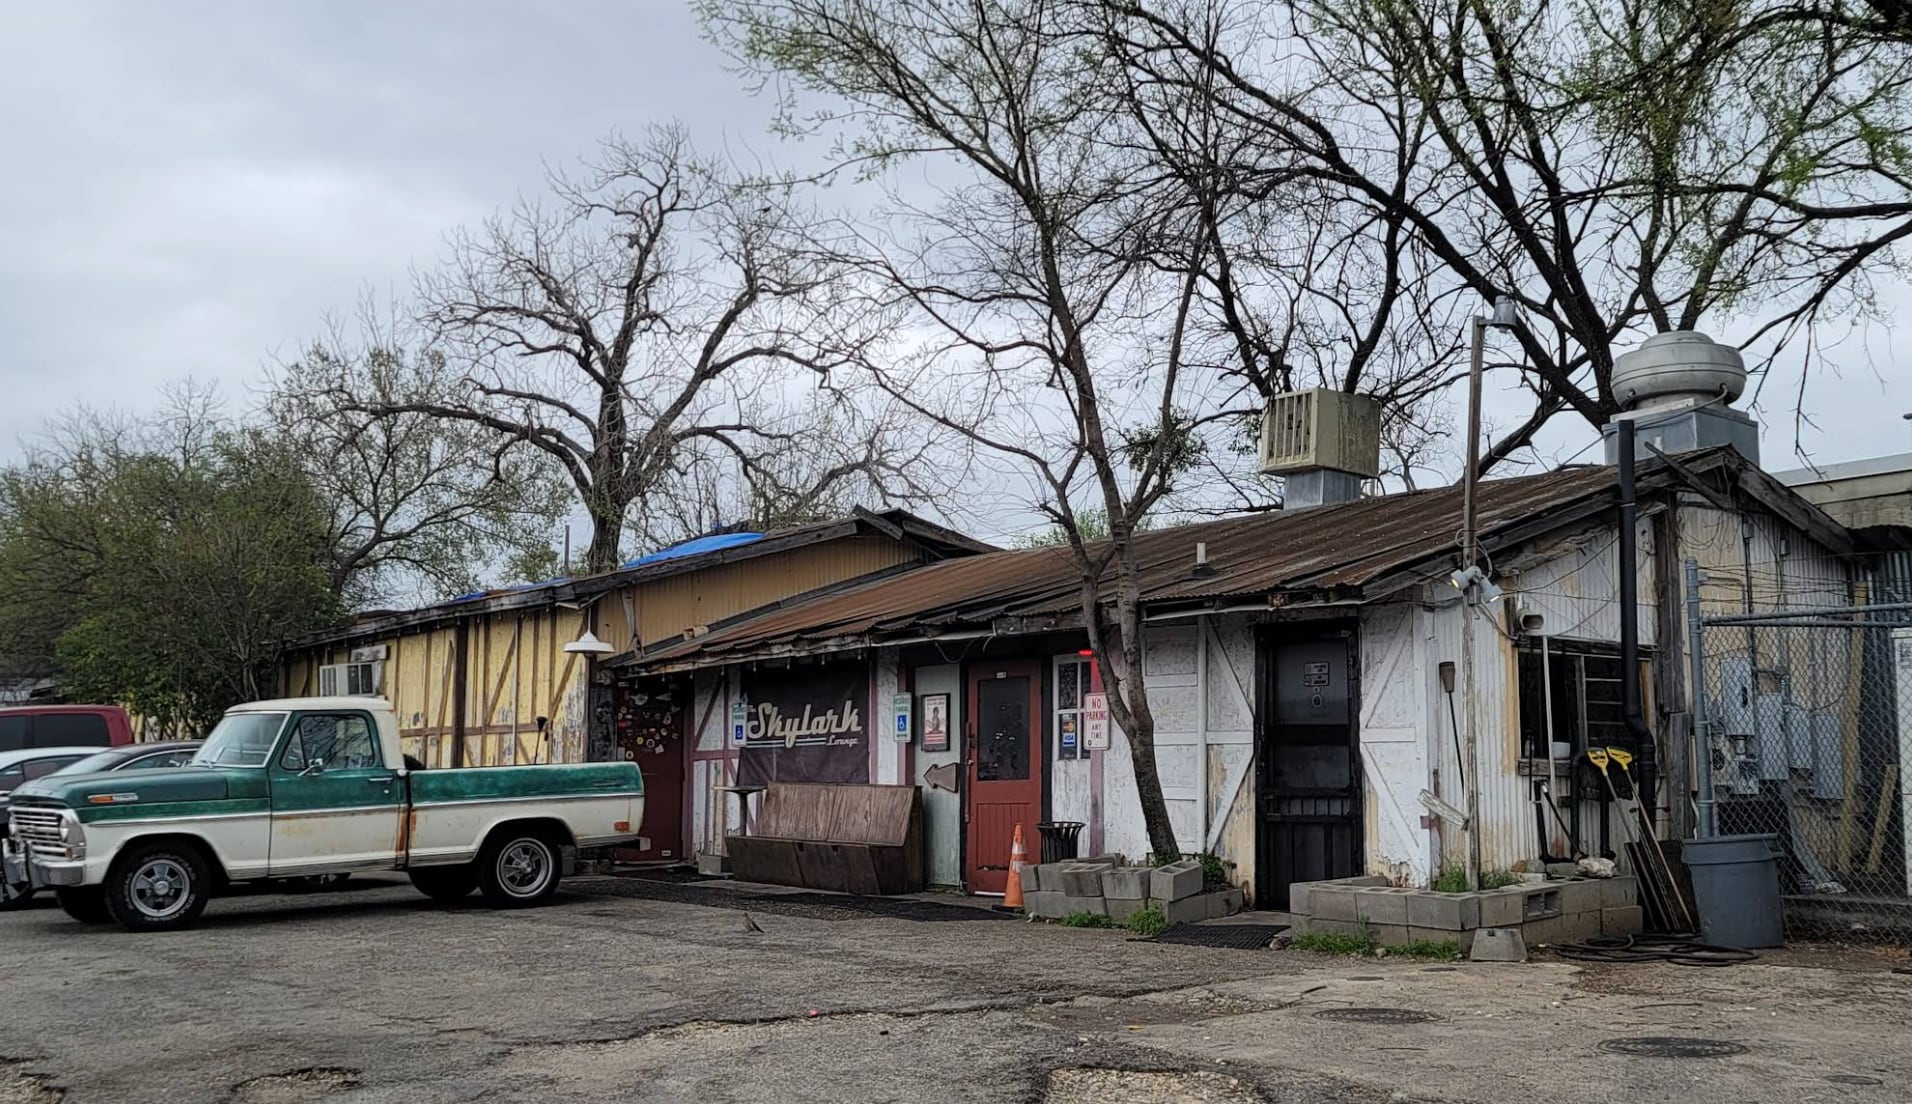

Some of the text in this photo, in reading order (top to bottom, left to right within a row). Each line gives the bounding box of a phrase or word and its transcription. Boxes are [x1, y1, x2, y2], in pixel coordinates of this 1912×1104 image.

[1091, 698, 1102, 709] NO
[1086, 711, 1107, 720] PARKING
[746, 700, 862, 748] Skylark
[825, 735, 858, 748] Lounge
